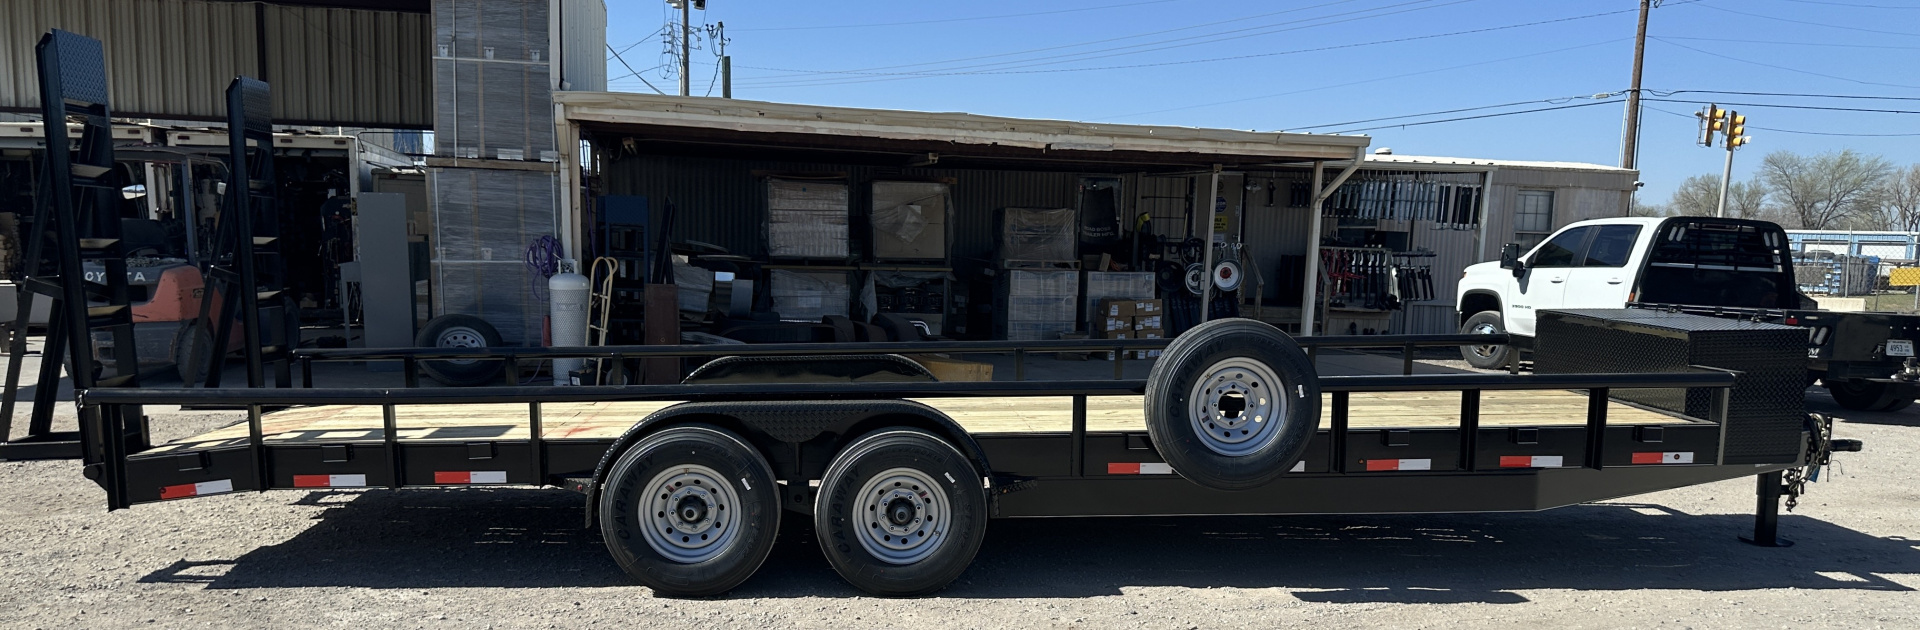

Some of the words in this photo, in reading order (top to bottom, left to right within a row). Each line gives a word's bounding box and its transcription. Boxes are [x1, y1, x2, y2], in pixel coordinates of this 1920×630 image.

[84, 271, 146, 282] OYTA
[1169, 337, 1226, 418] CARAWAY
[614, 453, 654, 540] CARAWAY
[831, 465, 861, 554] CARAWAY
